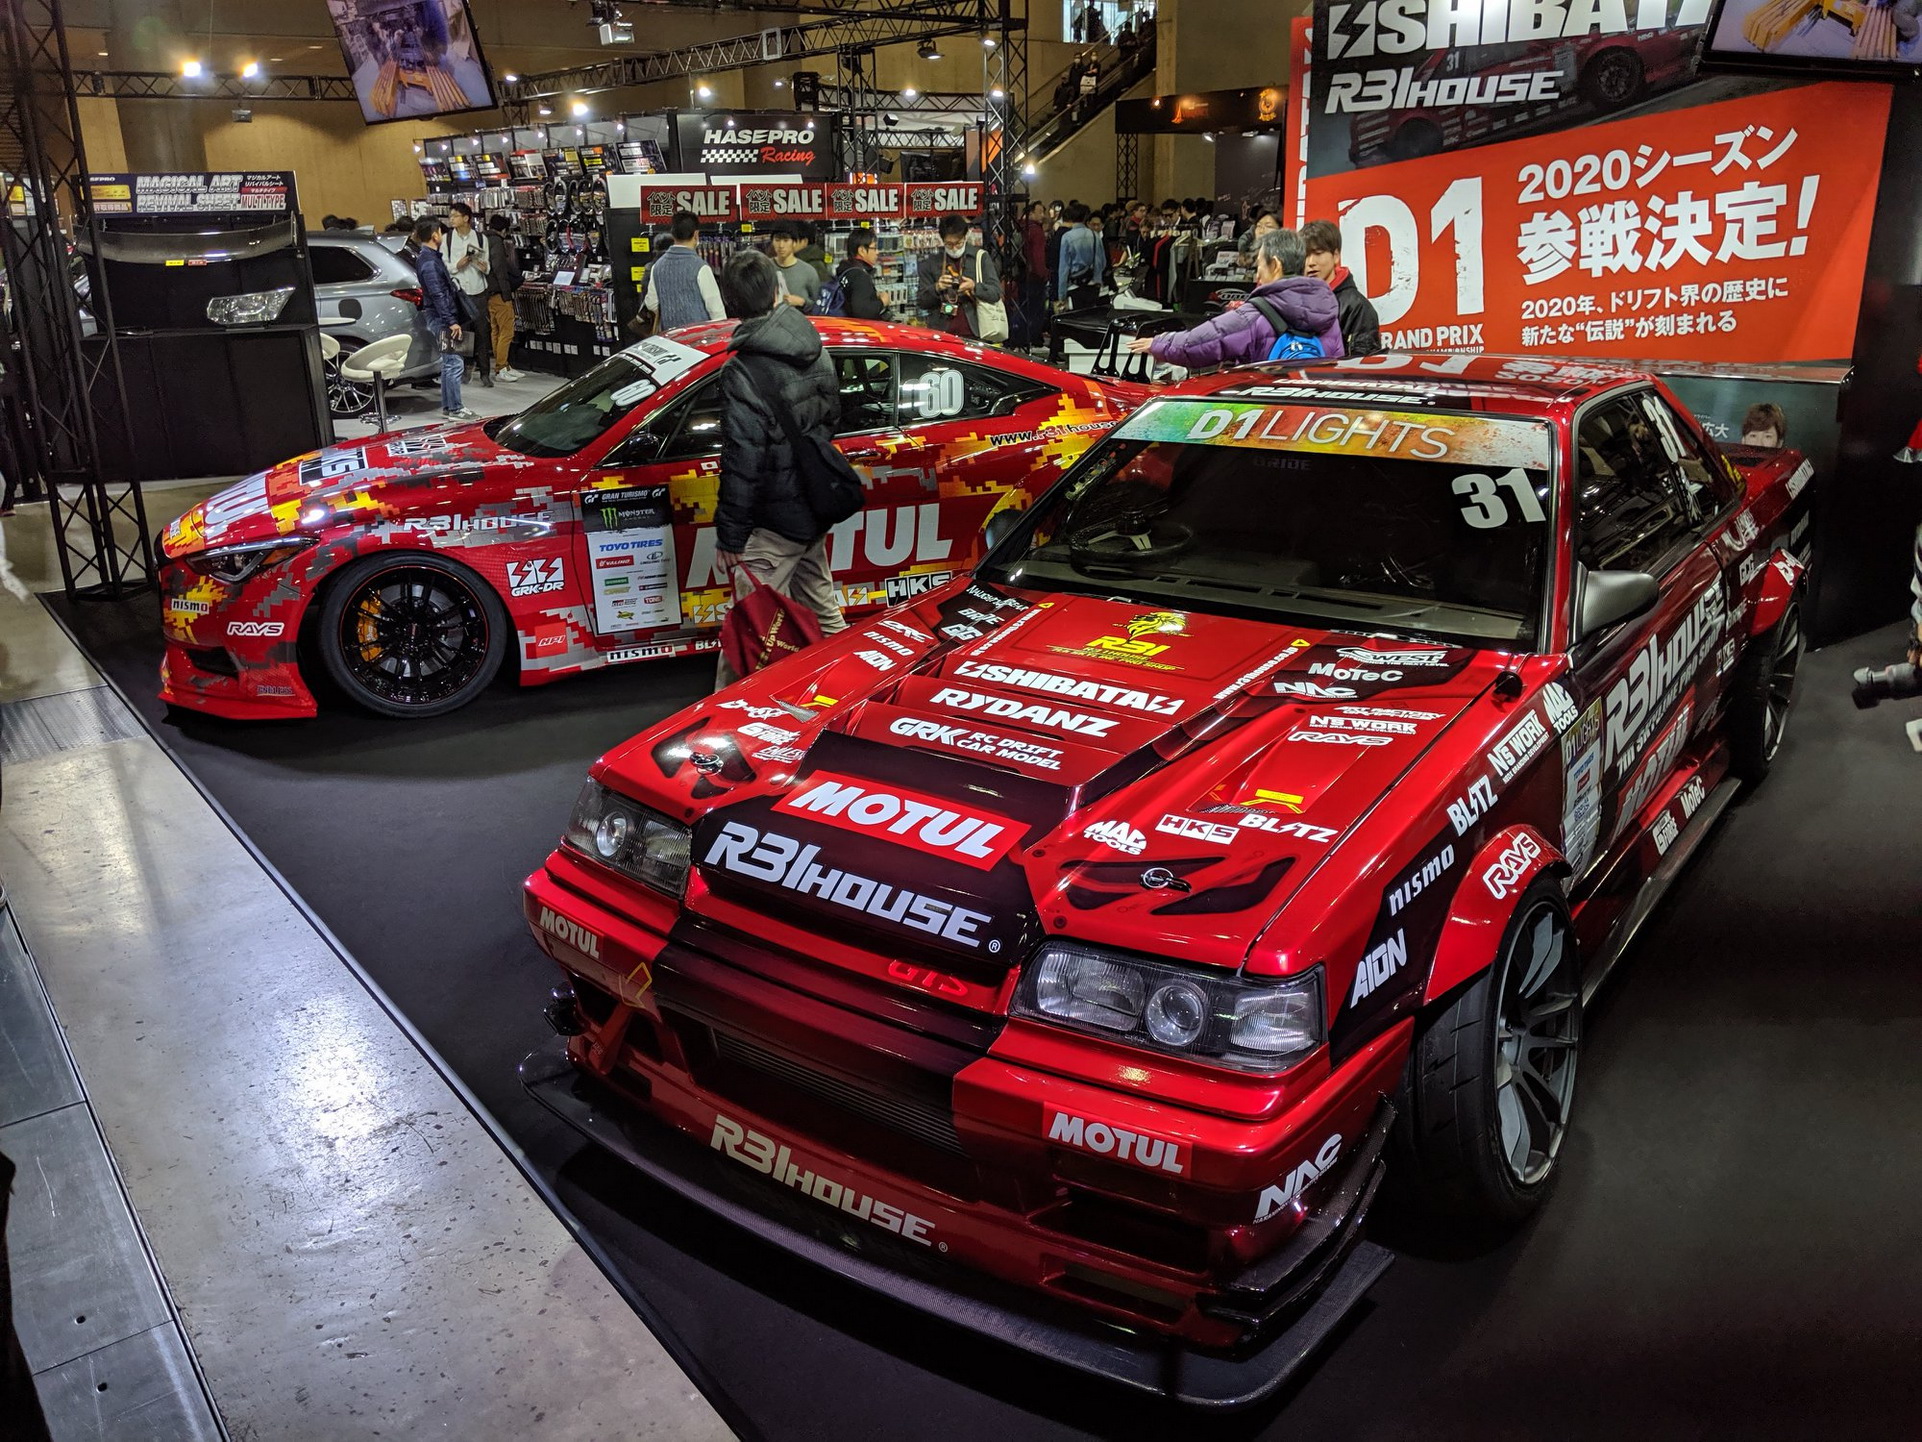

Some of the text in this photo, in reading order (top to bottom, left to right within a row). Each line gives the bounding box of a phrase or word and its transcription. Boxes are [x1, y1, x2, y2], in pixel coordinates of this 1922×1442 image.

[703, 129, 816, 145] HASEPRO
[760, 148, 816, 167] Racing
[1517, 124, 1798, 204] 2020シーズン
[136, 175, 207, 194] MAGICAL
[209, 174, 243, 193] ART
[137, 194, 194, 212] REVIVAL
[196, 193, 241, 211] SHEET
[650, 201, 674, 217] 限定
[677, 190, 730, 217] SALE
[749, 200, 770, 214] 限定
[773, 189, 823, 214] SALE
[834, 200, 853, 213] 限定
[855, 188, 899, 213] SALE
[913, 199, 932, 212] 限定
[934, 187, 978, 212] SALE
[1517, 174, 1820, 287] 参戦決定!
[1338, 175, 1487, 328] D1
[1520, 276, 1788, 320] 2020年、ドリフト界の歴史に
[1379, 323, 1485, 350] RAND PRIX
[601, 489, 648, 501] GRAN TURISMO
[1451, 467, 1547, 529] 31
[600, 538, 664, 553] TOYO TIRES
[227, 622, 285, 637] RAYS
[863, 631, 914, 657] nismo
[1085, 635, 1171, 657] R31
[976, 665, 1154, 711] SHIBATA
[929, 687, 1121, 738] RYDANZ
[1350, 718, 1418, 732] WORK
[1553, 704, 1579, 735] TOOLS
[889, 717, 972, 746] GRK
[1287, 731, 1394, 747] RAYS
[1508, 714, 1547, 757] WORK
[956, 739, 1061, 770] CAR MODEL
[967, 732, 1065, 759] RC DRIFT
[788, 781, 1005, 859] MOTUL
[1157, 815, 1240, 845] HKS
[1083, 830, 1142, 856] TOOLS
[1086, 820, 1148, 850] MAC
[1482, 832, 1542, 900] RAYS
[703, 820, 993, 949] R31HOUSE
[1389, 844, 1455, 917] nismo
[539, 906, 600, 959] MOTUL
[1048, 1111, 1184, 1175] MOTUL
[709, 1113, 936, 1247] R31HOUSE
[1253, 1132, 1343, 1220] NAC
